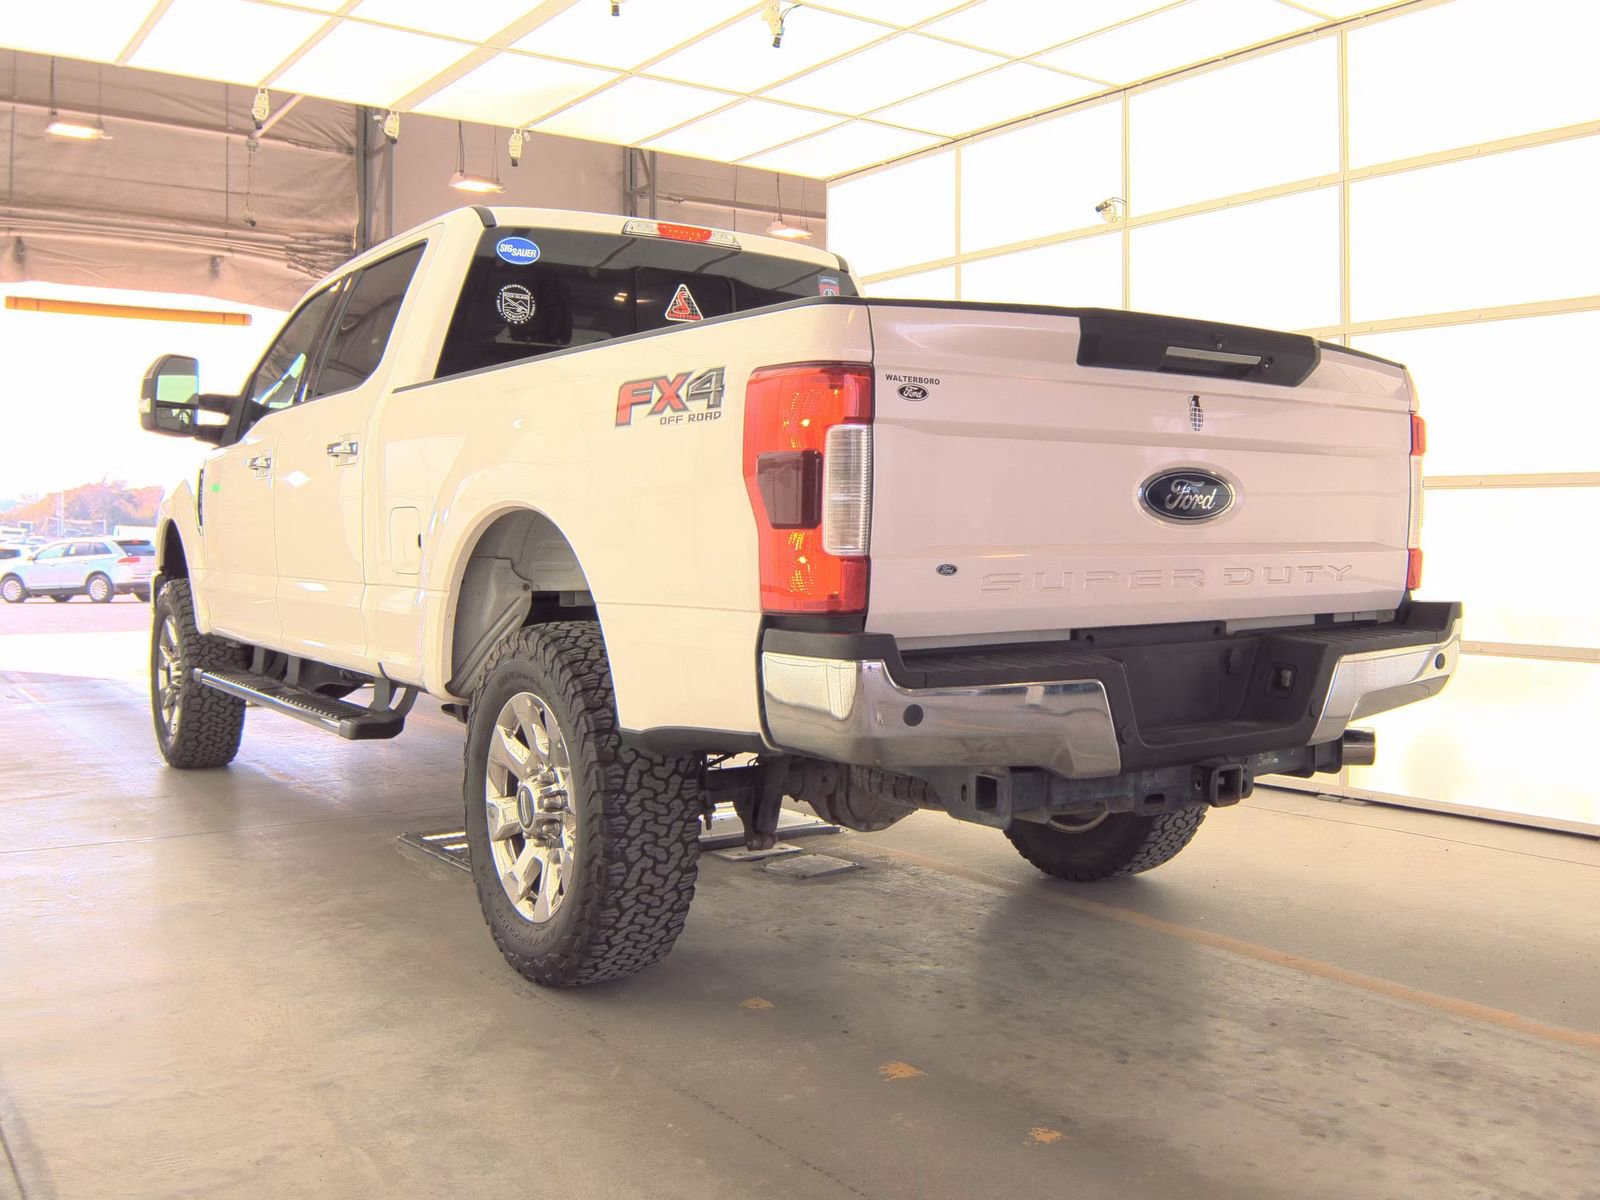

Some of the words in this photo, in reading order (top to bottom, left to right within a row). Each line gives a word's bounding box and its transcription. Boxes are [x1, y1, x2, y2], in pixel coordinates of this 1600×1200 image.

[500, 243, 513, 253] SIG
[511, 247, 537, 258] SAUER
[885, 373, 940, 385] WALTERBORO
[615, 365, 726, 427] FX4
[660, 414, 684, 425] OFF
[688, 411, 722, 422] ROAD
[1164, 479, 1218, 511] Ford
[980, 568, 1207, 593] SUPER
[1222, 563, 1353, 587] DUTY
